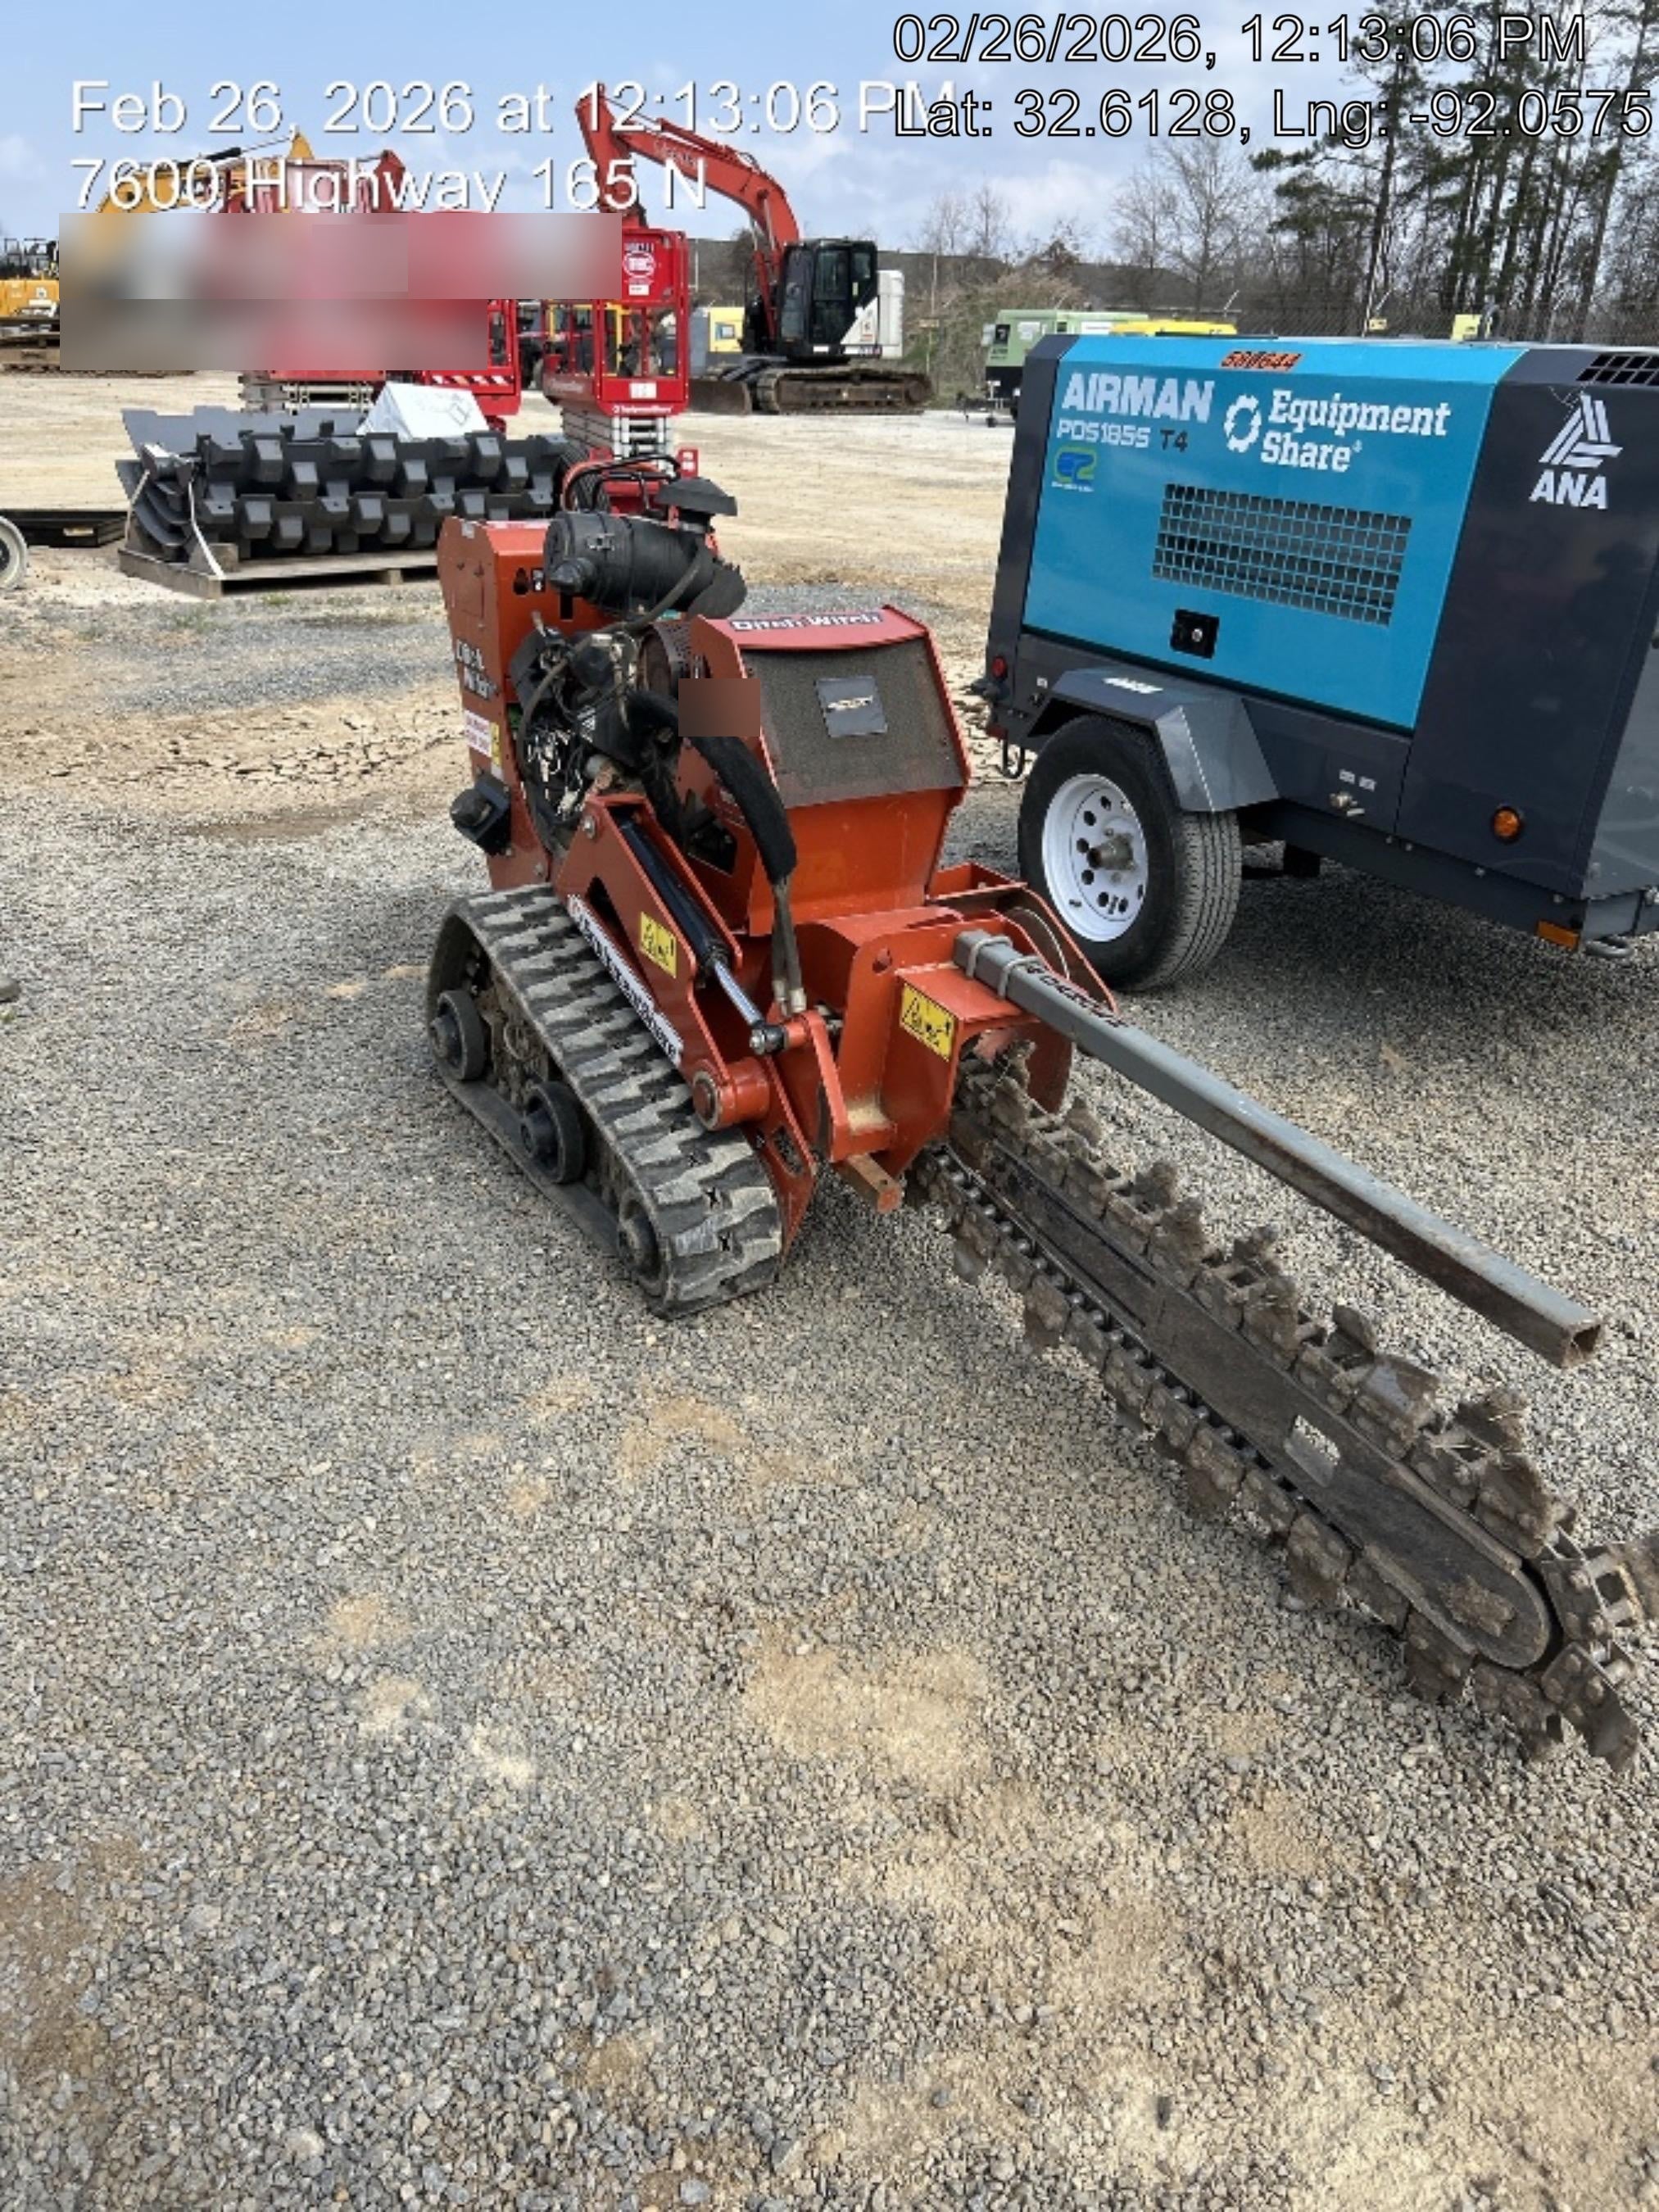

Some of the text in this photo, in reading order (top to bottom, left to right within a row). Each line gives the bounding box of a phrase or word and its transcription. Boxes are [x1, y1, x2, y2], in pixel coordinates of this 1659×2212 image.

[1061, 372, 1216, 424] AIRMAN
[1267, 388, 1452, 437] Equipment
[1159, 428, 1190, 453] T4
[1529, 469, 1608, 510] ANA
